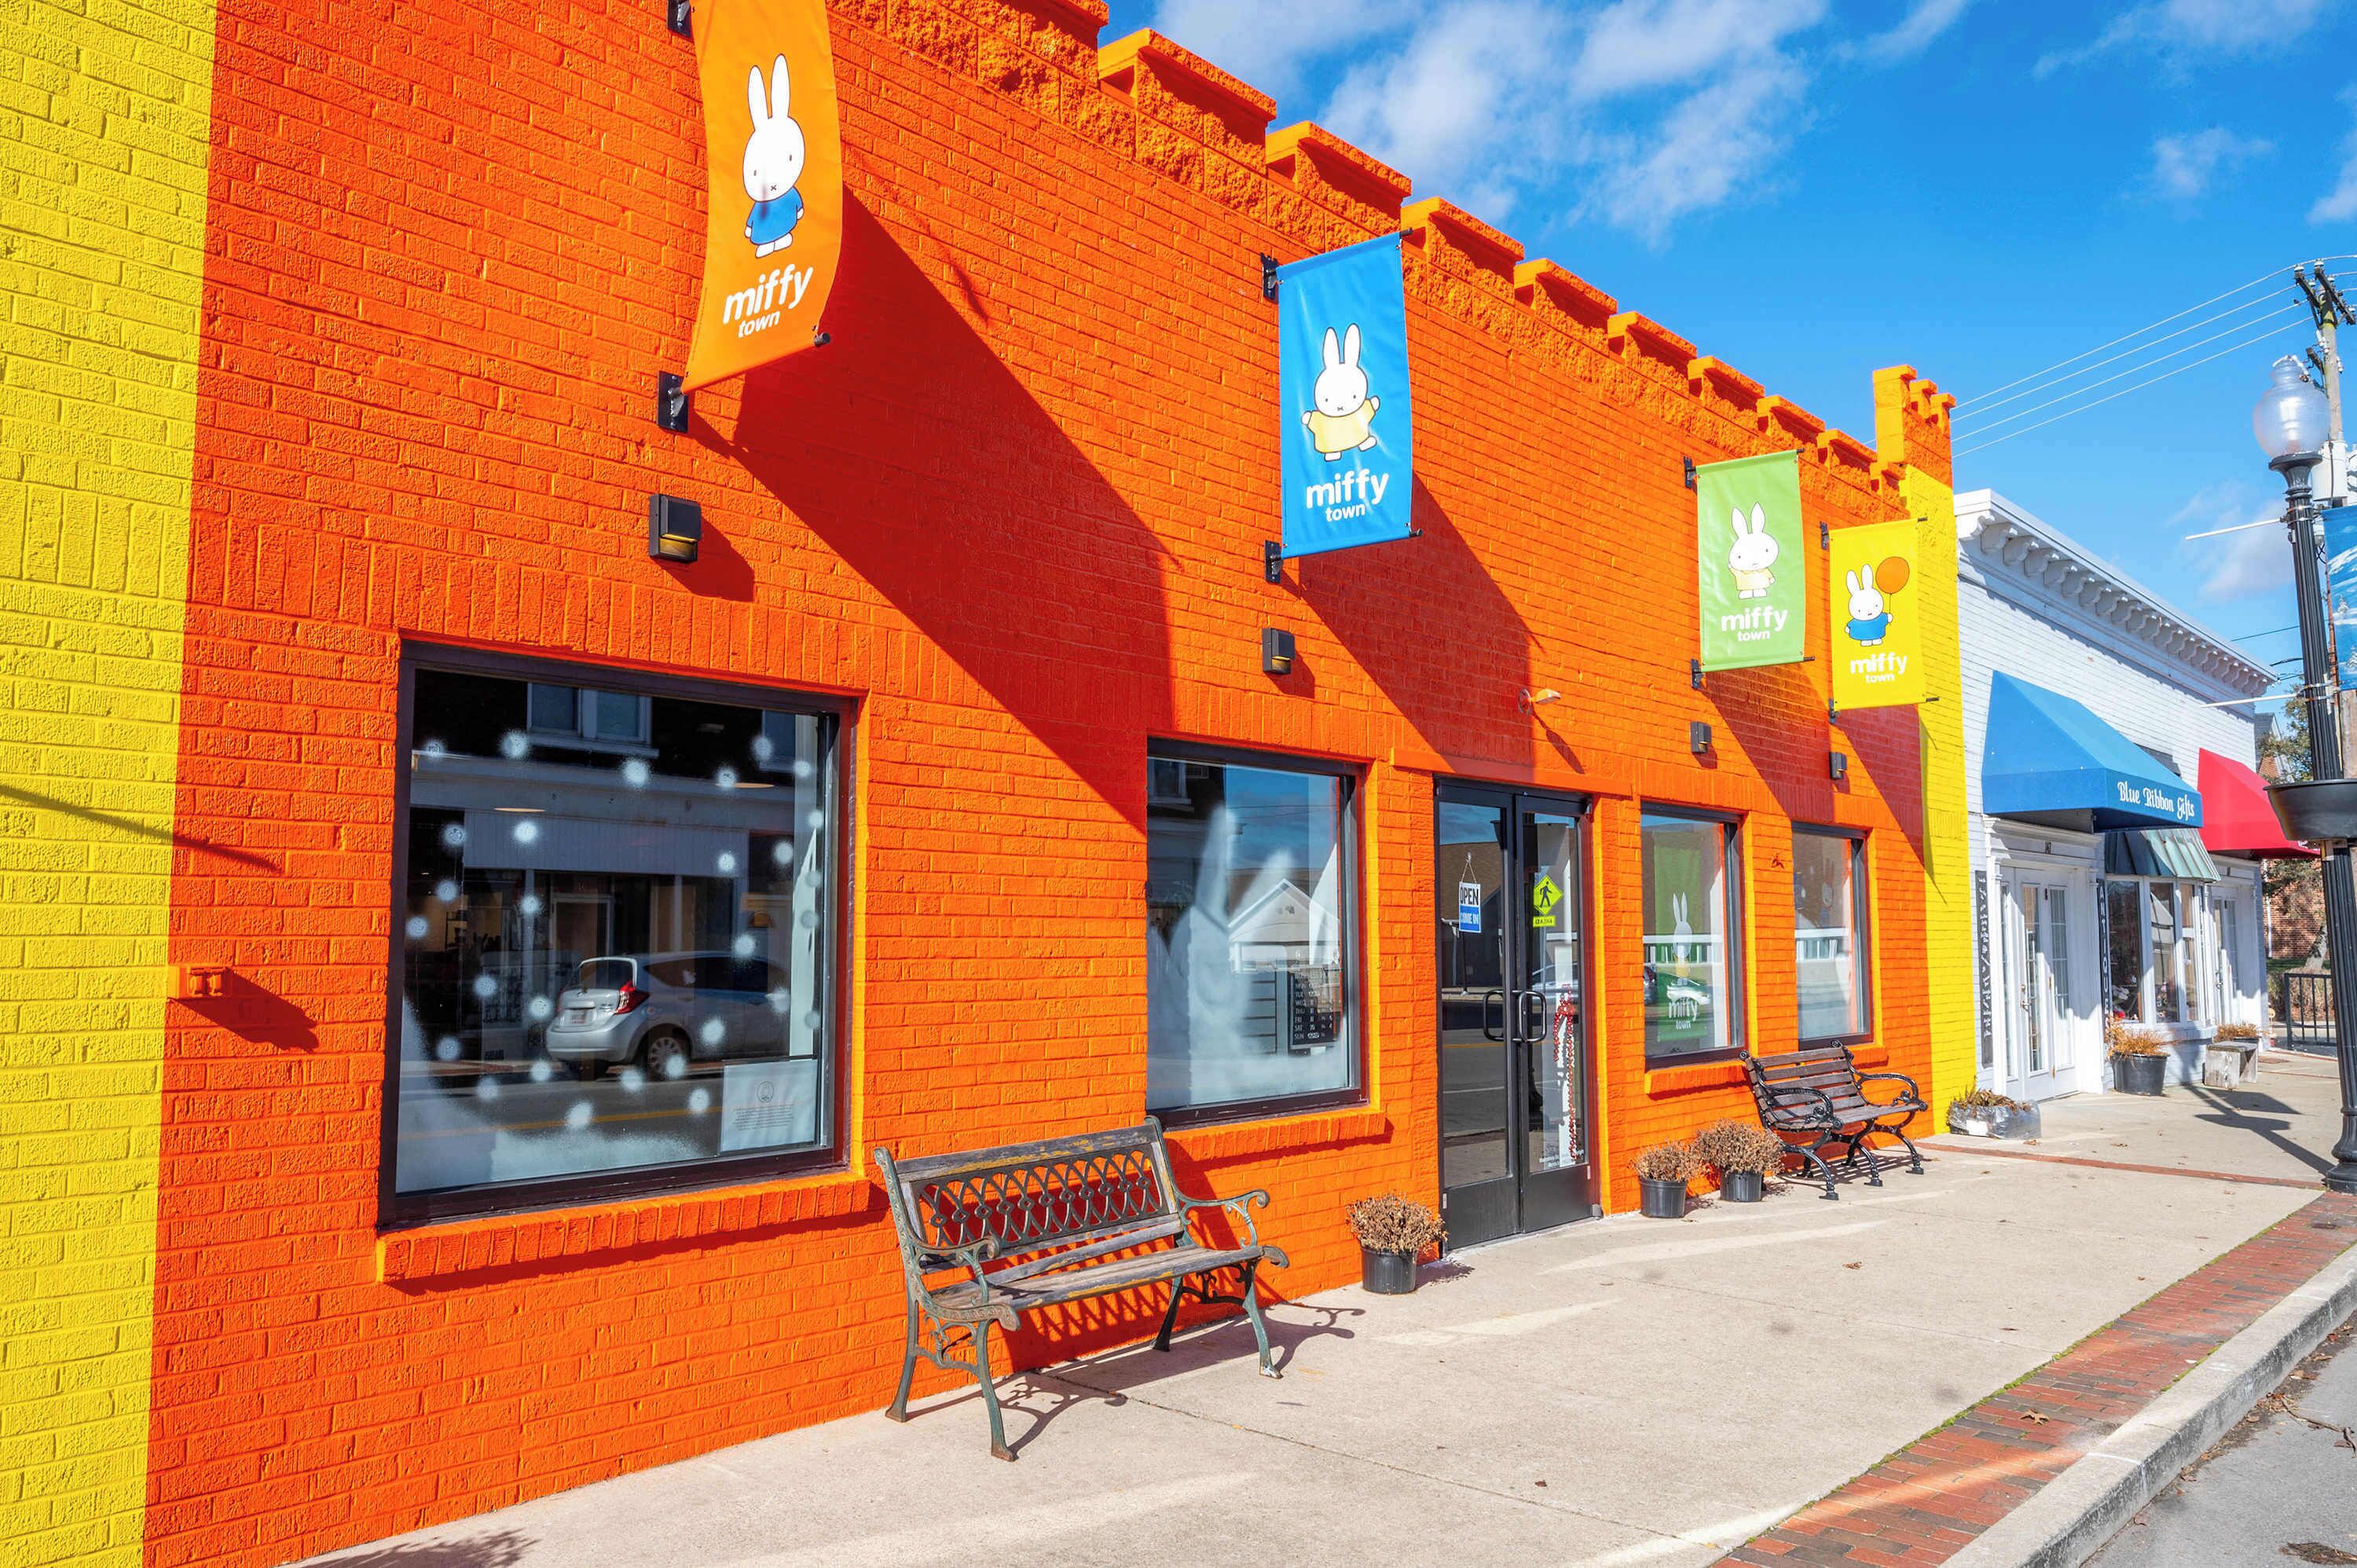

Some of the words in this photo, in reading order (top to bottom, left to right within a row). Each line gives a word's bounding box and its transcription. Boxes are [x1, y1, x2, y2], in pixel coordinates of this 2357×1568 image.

[723, 263, 814, 324] miffy
[738, 310, 781, 338] town
[1306, 468, 1390, 509] miffy
[1325, 504, 1365, 522] town
[1721, 605, 1789, 632] miffy
[1737, 630, 1770, 642] town
[1849, 652, 1908, 675] miffy
[1865, 673, 1895, 683] town
[2117, 781, 2141, 804] Blue
[2143, 787, 2175, 812] Ribbon
[2176, 793, 2195, 821] Gifts
[1460, 886, 1479, 905] OPEN
